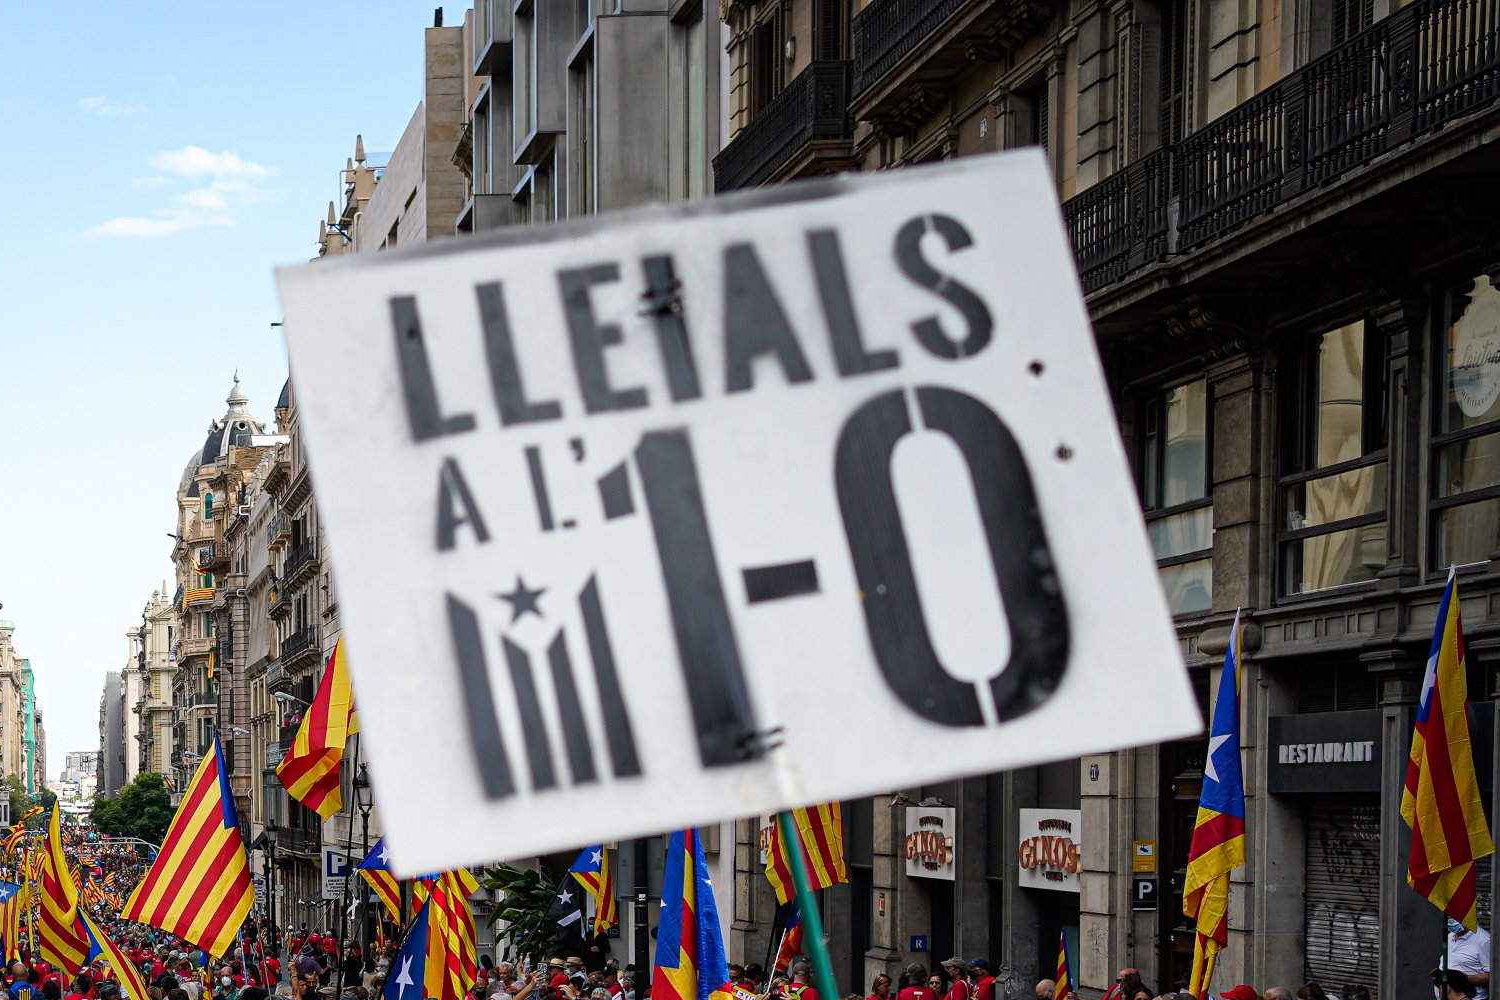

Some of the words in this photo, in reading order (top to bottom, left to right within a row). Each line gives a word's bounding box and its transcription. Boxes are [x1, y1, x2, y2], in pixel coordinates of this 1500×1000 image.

[389, 213, 993, 442] LLEIALS
[434, 455, 490, 551] A
[1279, 741, 1374, 764] RESTAURANT
[905, 831, 946, 864] GINOS
[1019, 835, 1078, 874] GINOS
[331, 855, 347, 874] P
[1139, 882, 1153, 899] P
[915, 939, 923, 948] R
